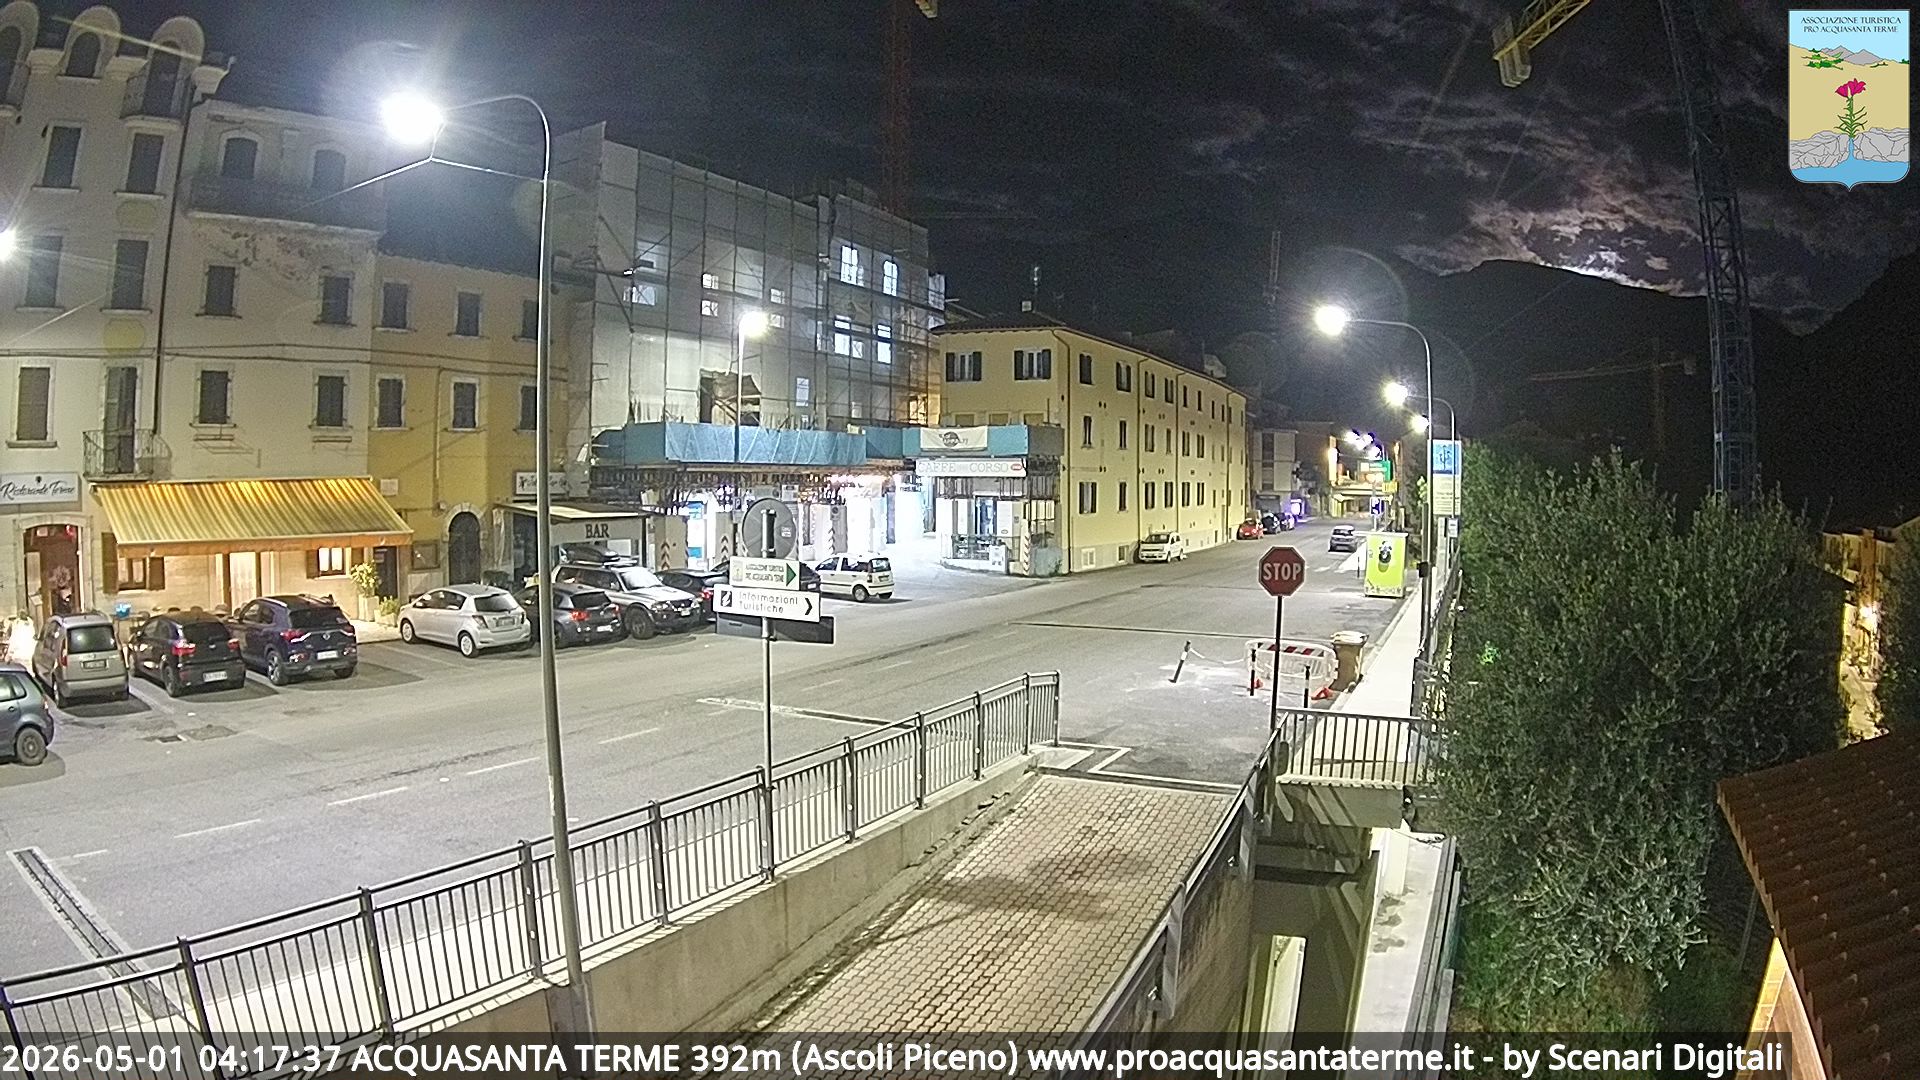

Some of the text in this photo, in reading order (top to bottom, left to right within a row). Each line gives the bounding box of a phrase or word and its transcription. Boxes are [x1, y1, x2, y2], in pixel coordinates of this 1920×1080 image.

[969, 462, 1009, 473] CORSO
[585, 523, 610, 538] BAR
[1263, 562, 1302, 581] STOP
[739, 591, 798, 605] Informazioni
